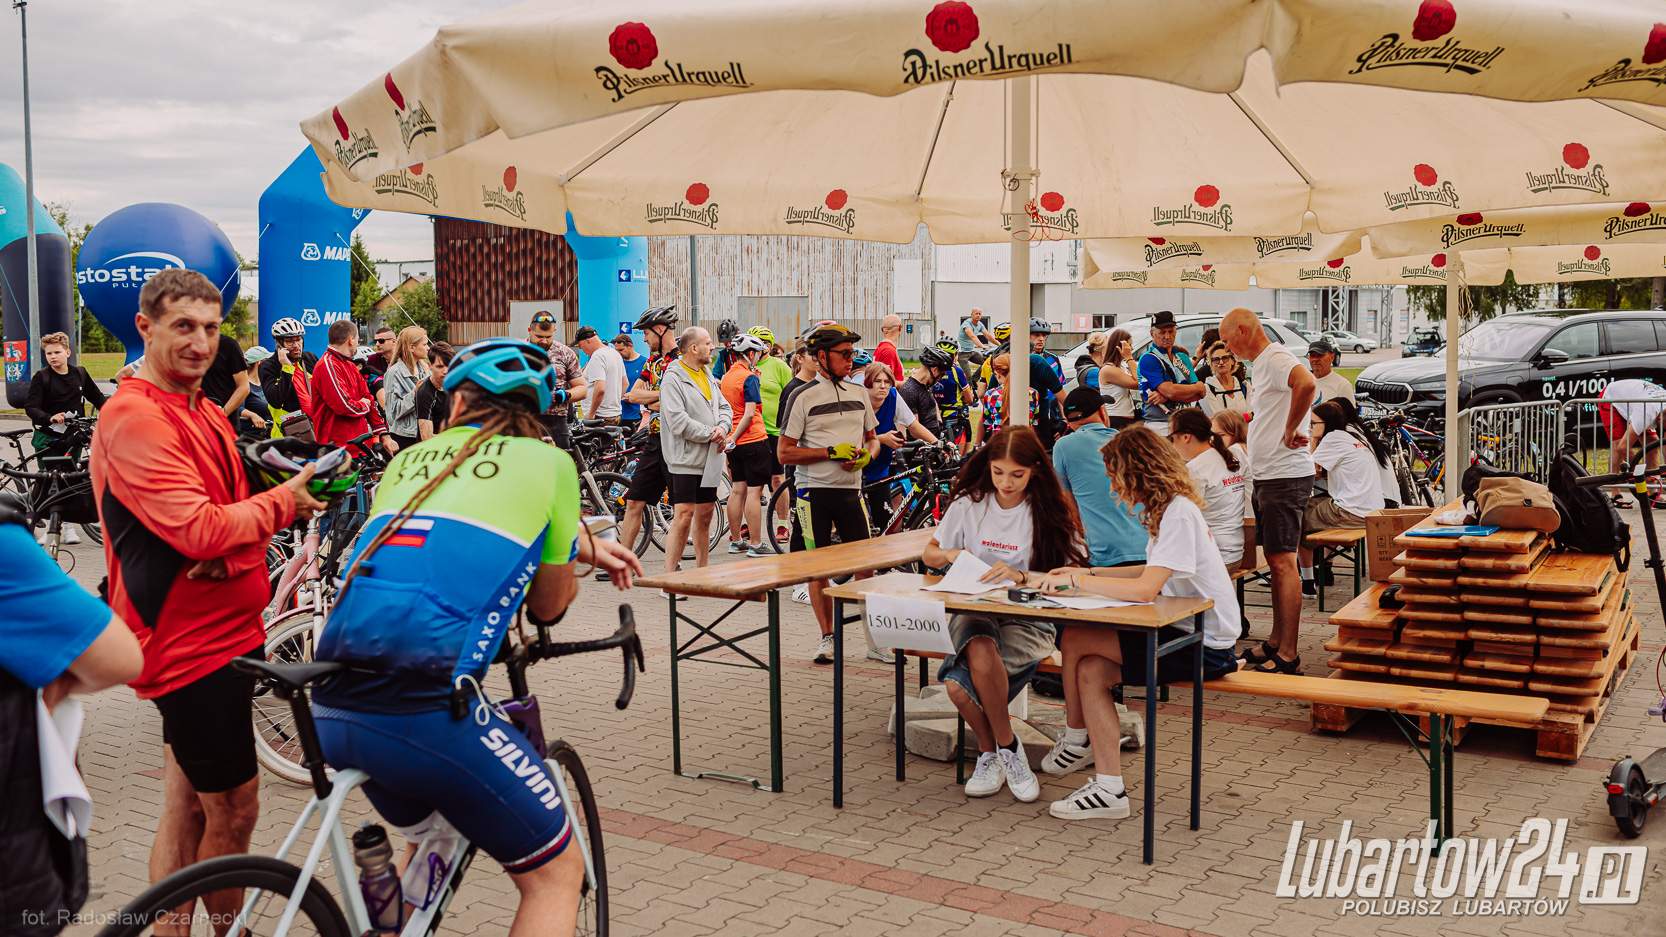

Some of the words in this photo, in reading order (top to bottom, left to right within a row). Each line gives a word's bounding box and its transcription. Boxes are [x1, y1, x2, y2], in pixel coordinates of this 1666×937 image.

[902, 48, 988, 84] Pilsner
[985, 41, 1072, 71] Urquell
[1348, 33, 1437, 74] Pilsner
[1434, 37, 1505, 73] Urquell
[594, 65, 670, 102] Pilsner
[665, 60, 746, 86] Urquell
[1441, 224, 1485, 249] Pilsner
[1483, 223, 1524, 238] Urquell
[1604, 216, 1650, 240] Pilsner
[1144, 244, 1174, 267] Pilsner
[1171, 240, 1202, 258] Urquell
[76, 264, 172, 284] stosta
[1542, 380, 1566, 399] 0,4
[401, 440, 510, 467] Tinkff
[472, 611, 500, 662] SAXO
[502, 561, 537, 608] BANK
[868, 614, 941, 633] 1501-2000
[480, 728, 562, 810] SILVINI
